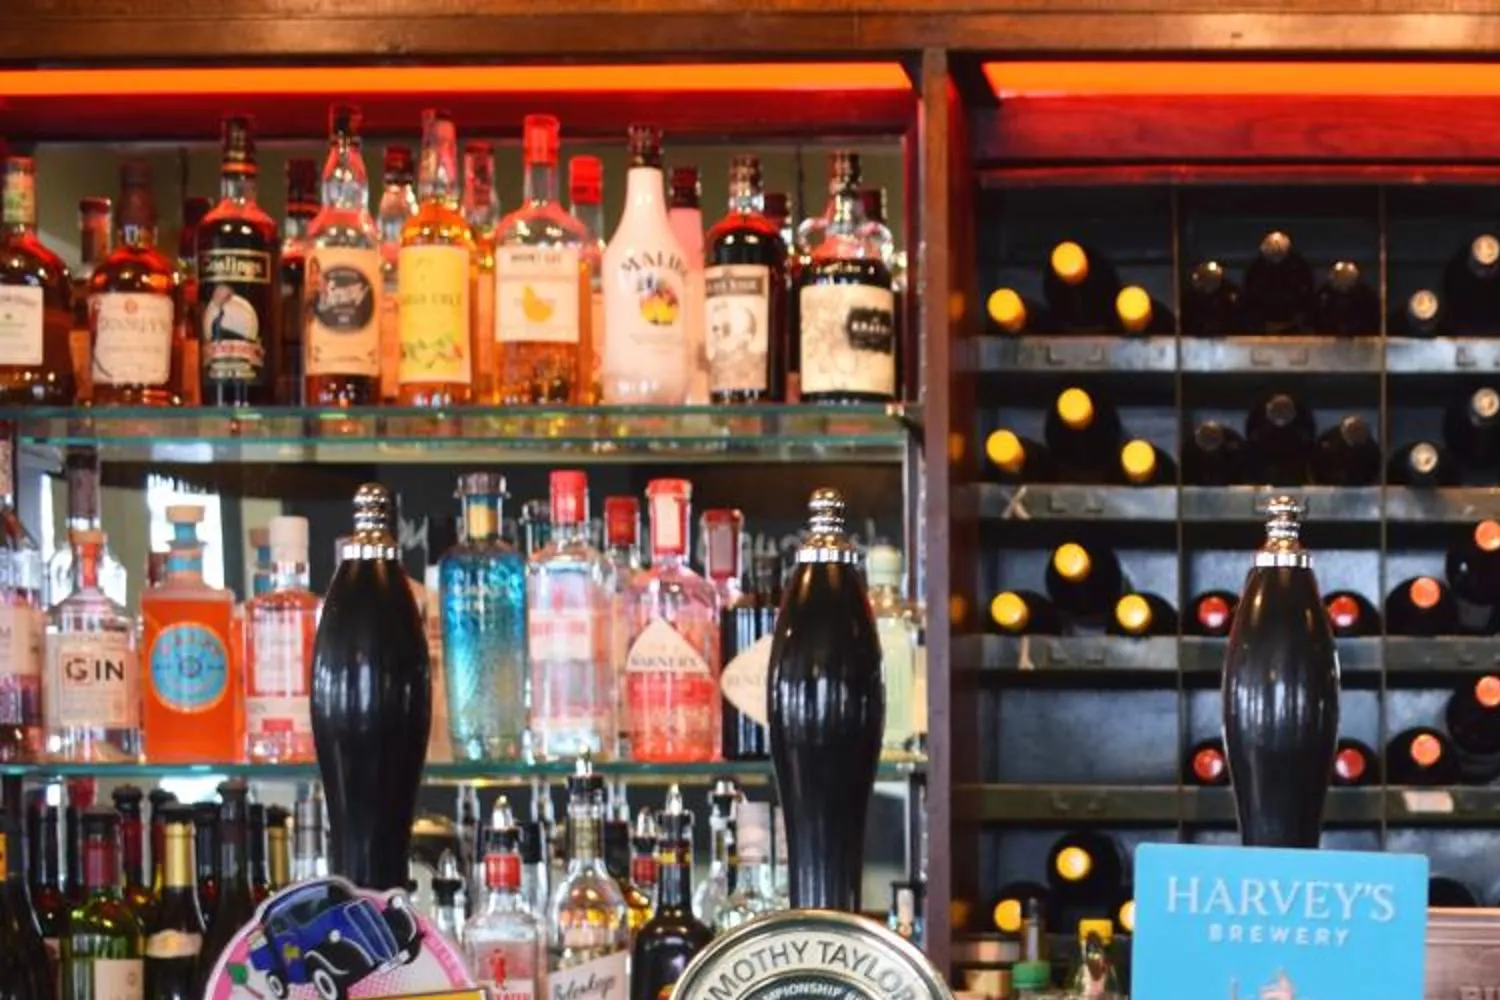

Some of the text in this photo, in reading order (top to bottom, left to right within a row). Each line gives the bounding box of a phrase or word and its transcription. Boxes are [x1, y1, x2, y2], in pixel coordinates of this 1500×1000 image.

[65, 658, 124, 681] GIN
[1166, 876, 1395, 922] HARVEY'S
[1208, 923, 1349, 946] BREWERY
